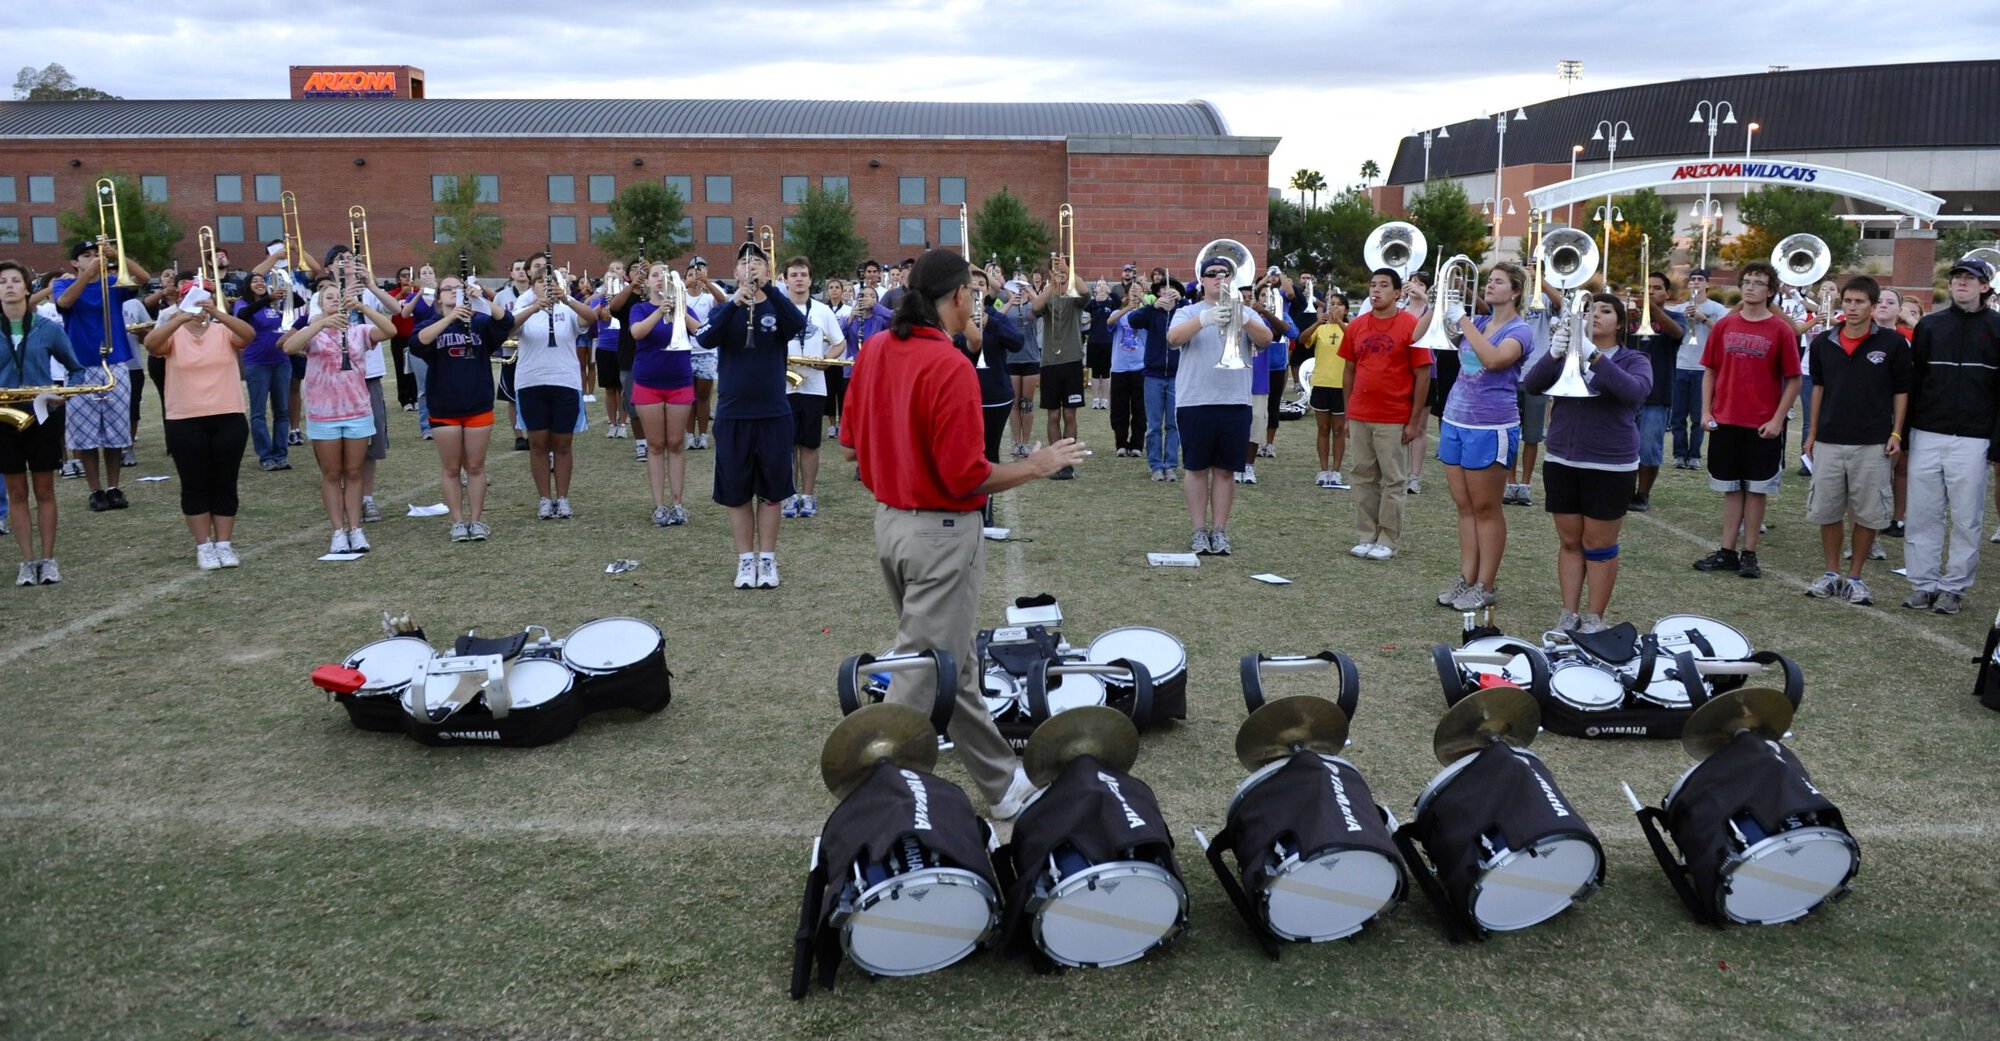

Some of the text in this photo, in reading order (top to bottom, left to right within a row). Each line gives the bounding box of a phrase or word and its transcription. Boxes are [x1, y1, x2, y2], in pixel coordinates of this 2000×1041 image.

[303, 71, 397, 91] ARIZONA
[1672, 163, 1818, 182] ARIZONA WILDCATS
[436, 332, 482, 349] WILDCTS
[450, 730, 501, 740] YAMAHA
[1601, 726, 1647, 735] YAMAHA
[1531, 768, 1570, 817] AMAHA
[905, 779, 932, 830] YAMAHA
[1330, 774, 1363, 832] YAMAHA
